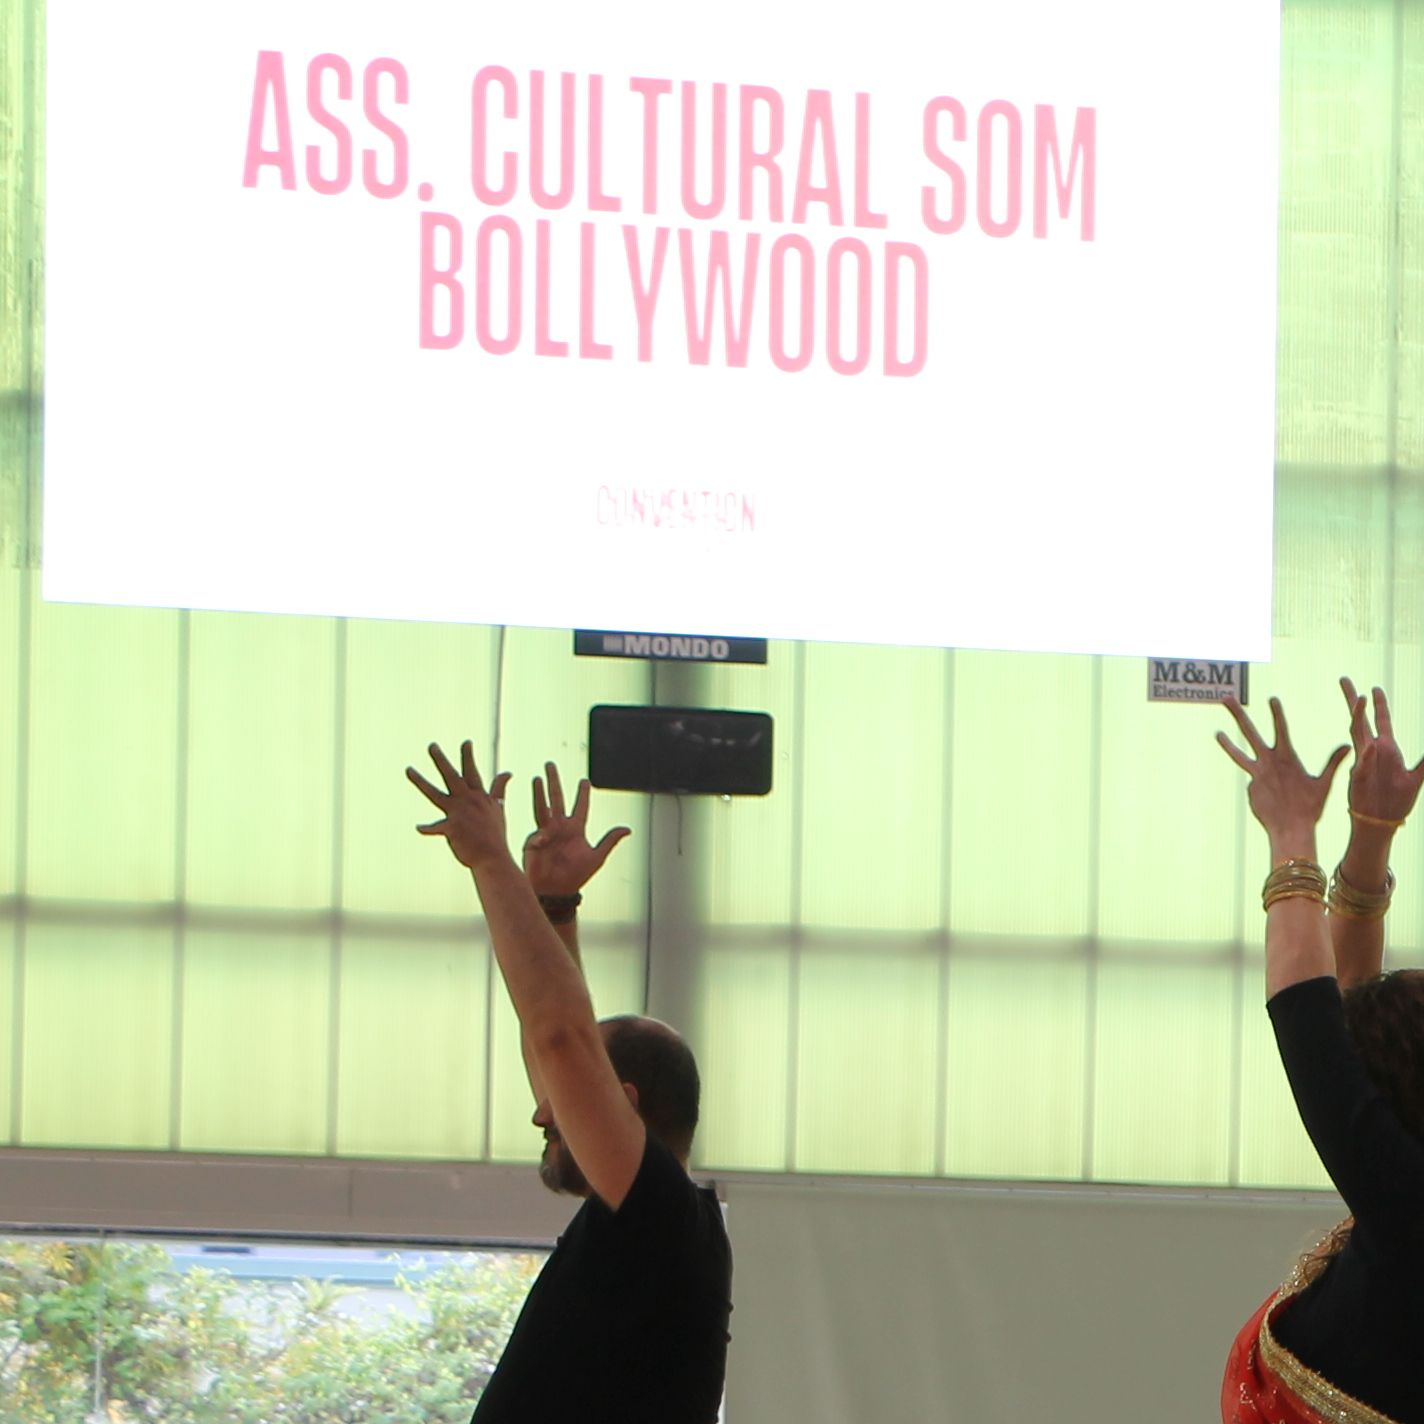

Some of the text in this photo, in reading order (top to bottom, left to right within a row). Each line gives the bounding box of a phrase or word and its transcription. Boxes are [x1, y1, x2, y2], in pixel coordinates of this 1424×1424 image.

[241, 50, 1097, 242] ASS. CULTURAL SOM
[418, 211, 929, 377] BOLLYWOOD
[624, 634, 730, 660] MONDO
[1153, 660, 1235, 685] M&M
[1153, 683, 1235, 700] Electronics
